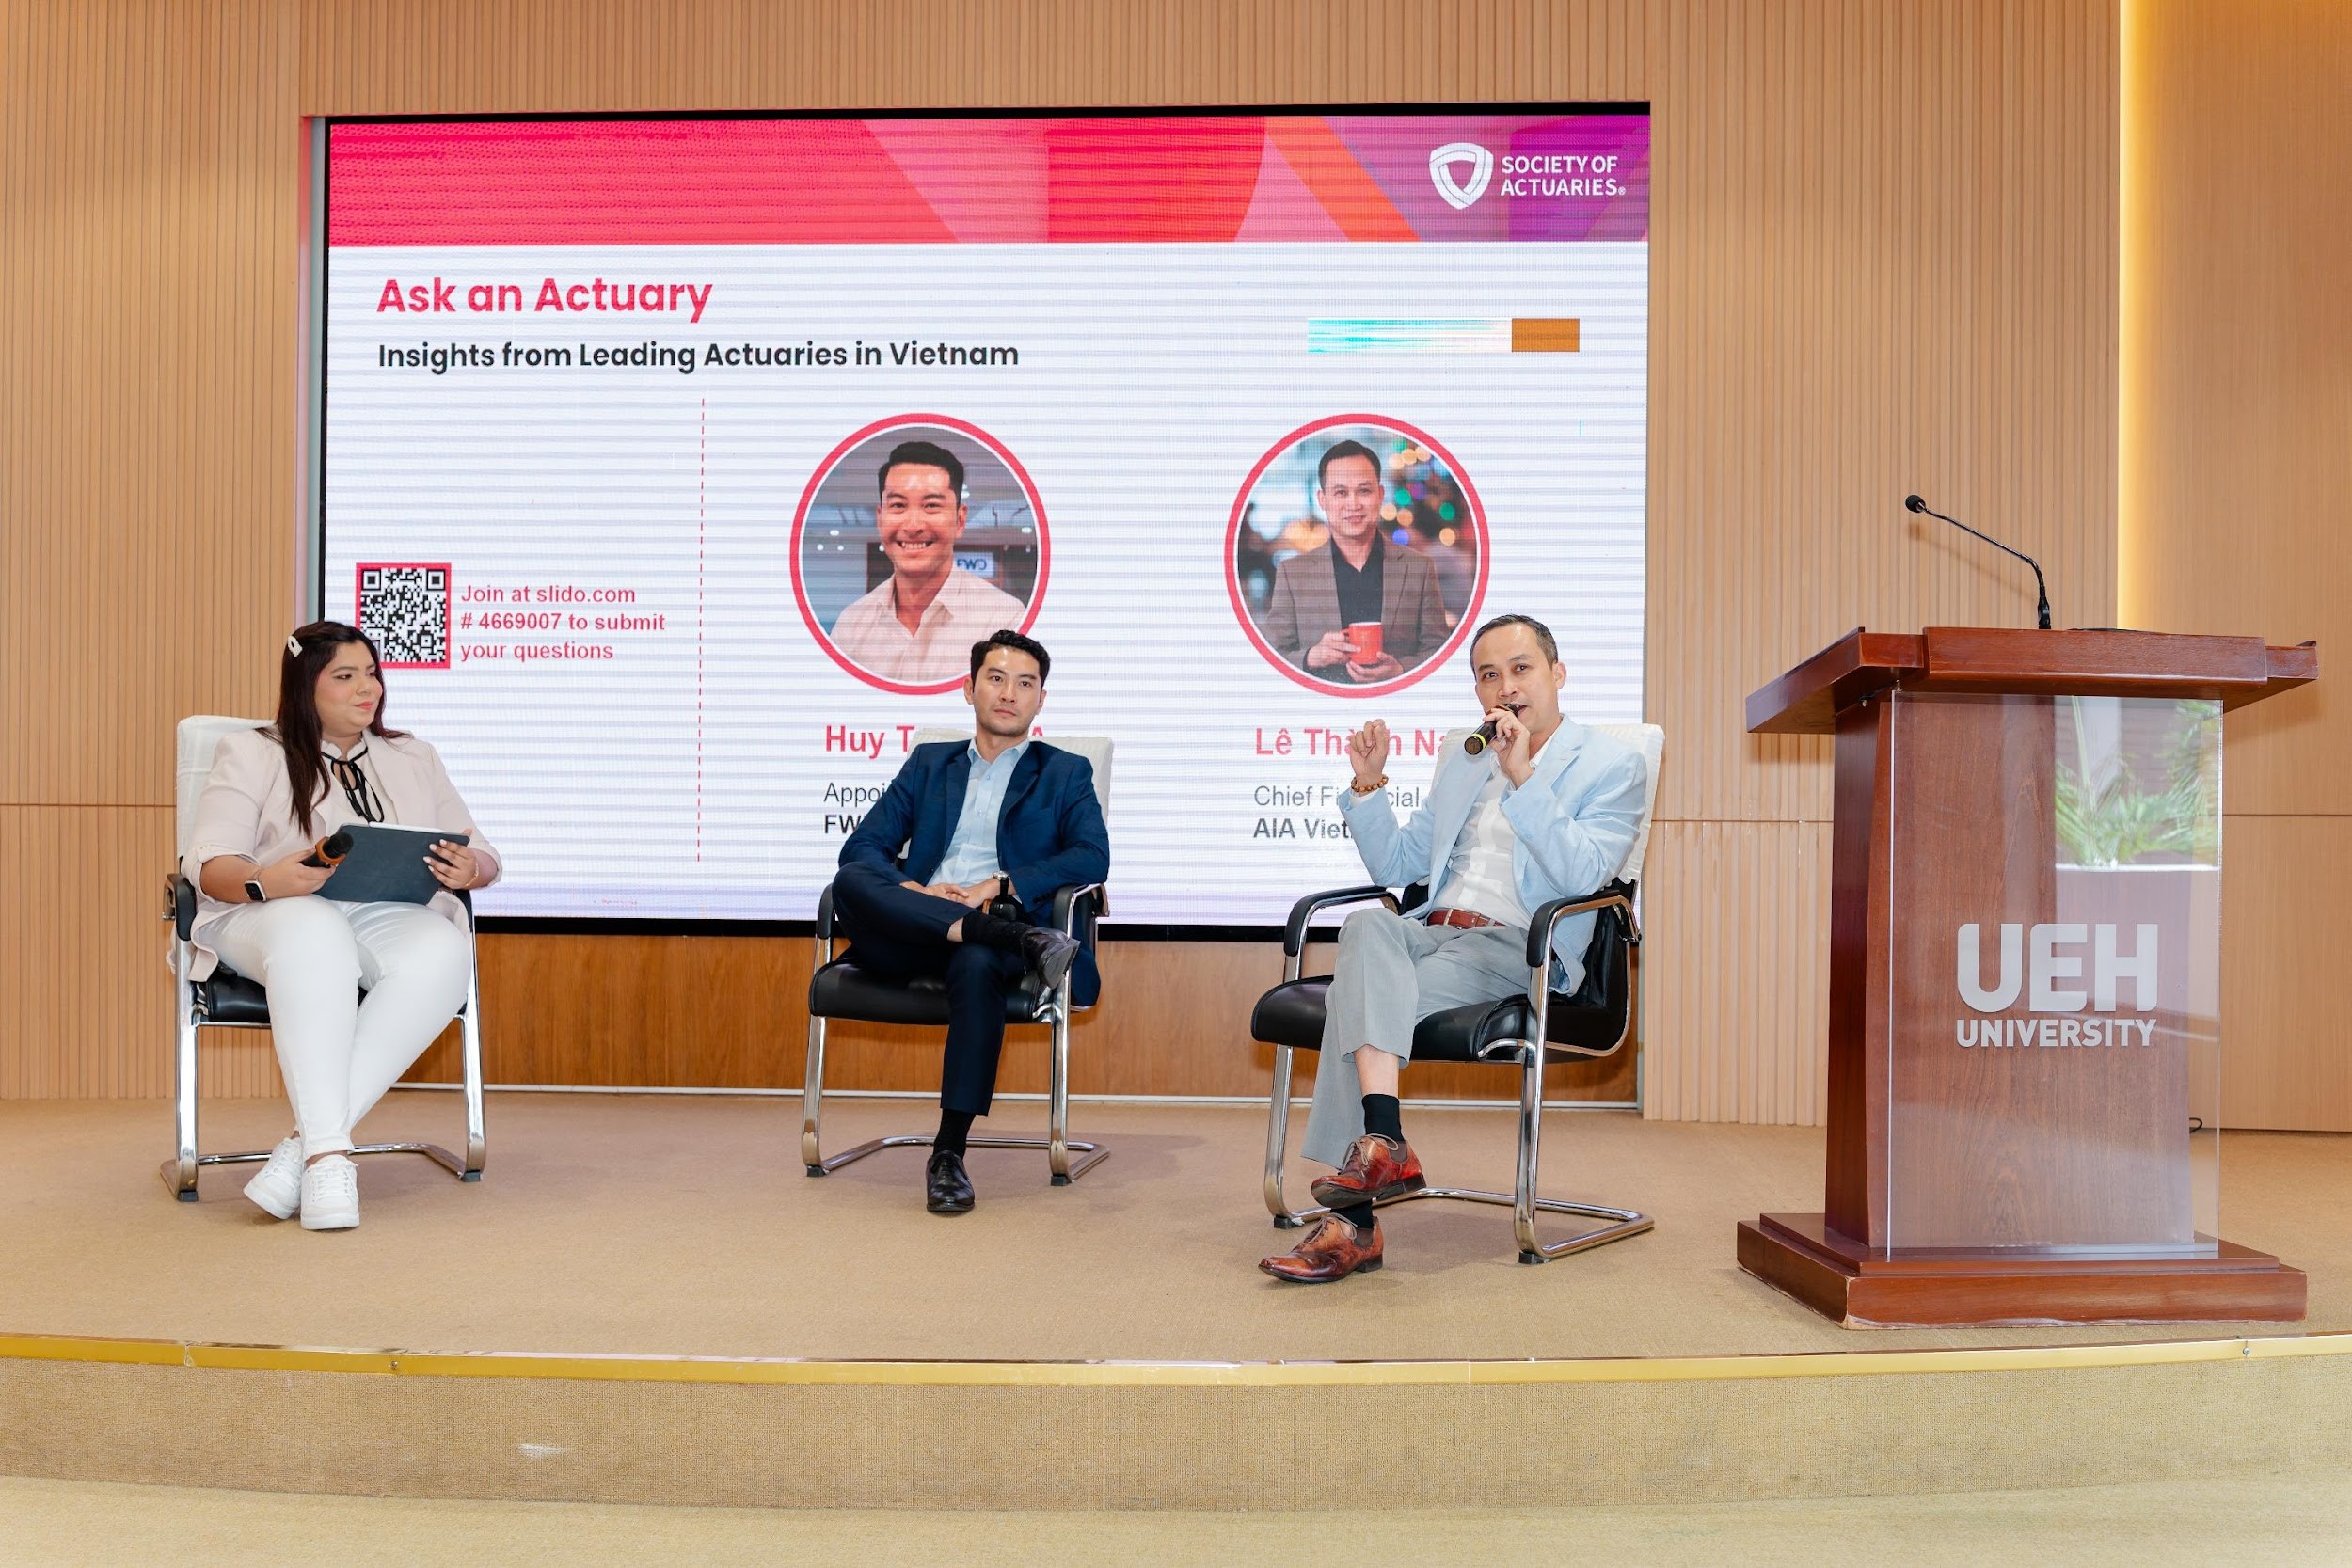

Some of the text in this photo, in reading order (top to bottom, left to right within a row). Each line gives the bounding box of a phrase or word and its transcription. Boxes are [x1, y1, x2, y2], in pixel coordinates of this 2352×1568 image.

[1502, 155, 1618, 174] SOCIETY OF
[376, 277, 713, 324] Ask an Actuary
[379, 340, 1019, 375] Insights from Leading Actuaries in Vietnam
[461, 585, 636, 602] Join at slido.com
[460, 613, 665, 630] # 4669007 to submit
[461, 641, 613, 662] your questions
[825, 725, 884, 759] Huy
[1256, 728, 1293, 755] Lê
[1254, 785, 1313, 806] Chief
[1253, 818, 1295, 838] AIA
[1957, 923, 2158, 1013] UEH
[1957, 1019, 2156, 1048] UNIVERSITY
